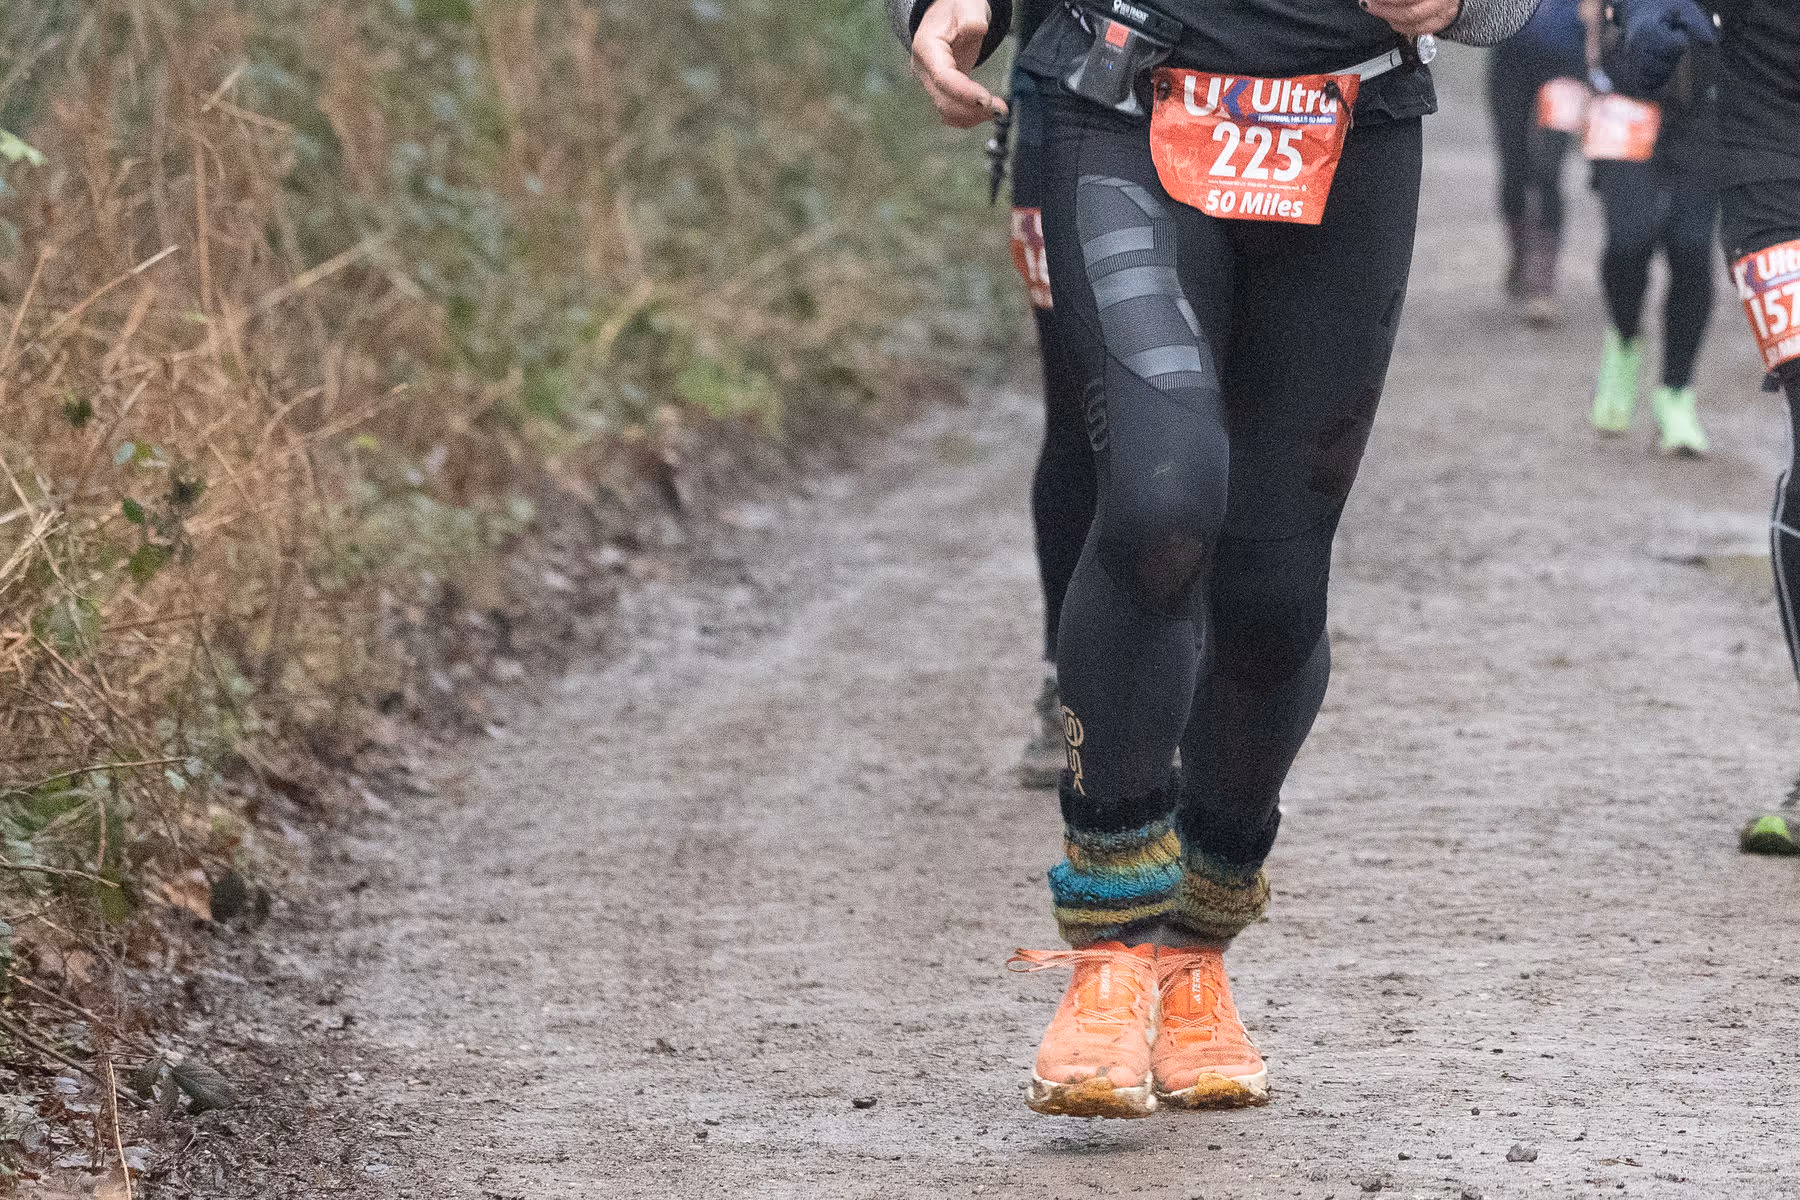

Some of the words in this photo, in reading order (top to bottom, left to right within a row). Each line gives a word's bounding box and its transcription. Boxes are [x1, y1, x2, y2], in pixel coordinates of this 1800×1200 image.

[1184, 75, 1250, 121] UK
[1252, 80, 1338, 113] Ultra
[1209, 122, 1303, 182] 225
[1206, 189, 1236, 213] 50
[1239, 191, 1304, 218] Miles
